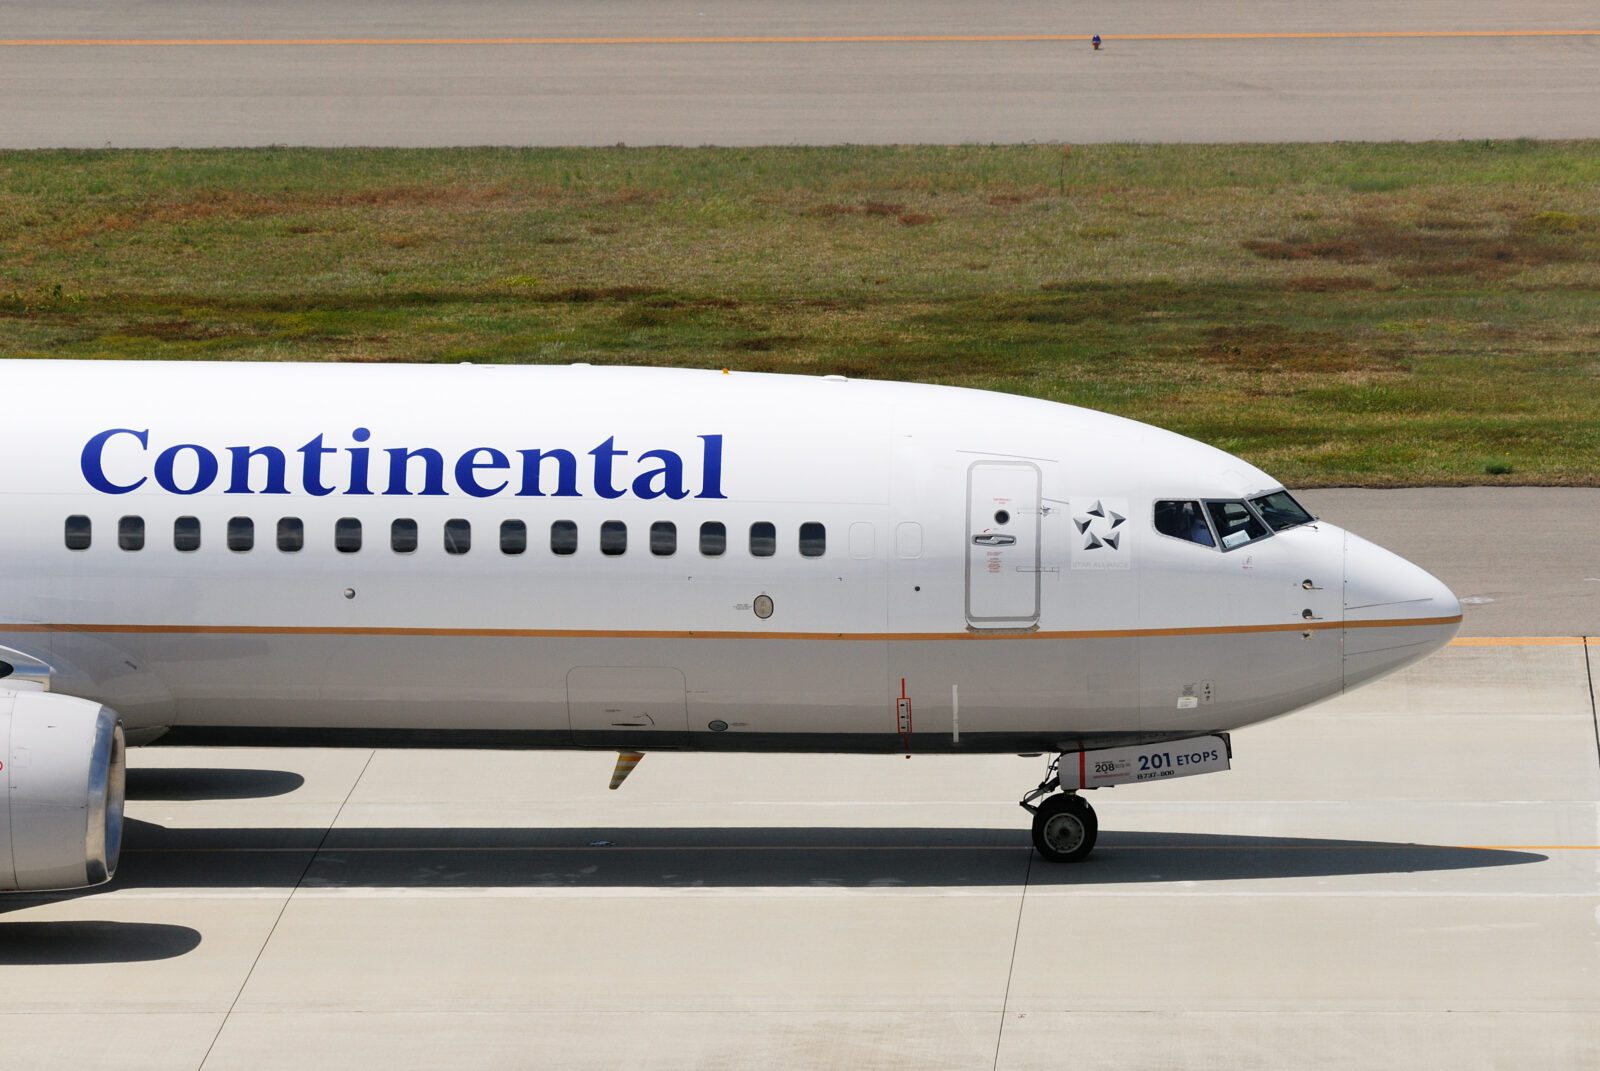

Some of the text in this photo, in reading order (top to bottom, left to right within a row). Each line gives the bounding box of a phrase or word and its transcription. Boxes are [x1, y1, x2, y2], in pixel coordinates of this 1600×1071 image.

[81, 427, 728, 499] Continental
[1095, 763, 1115, 773] 208
[1138, 750, 1218, 771] 201 ETOPS
